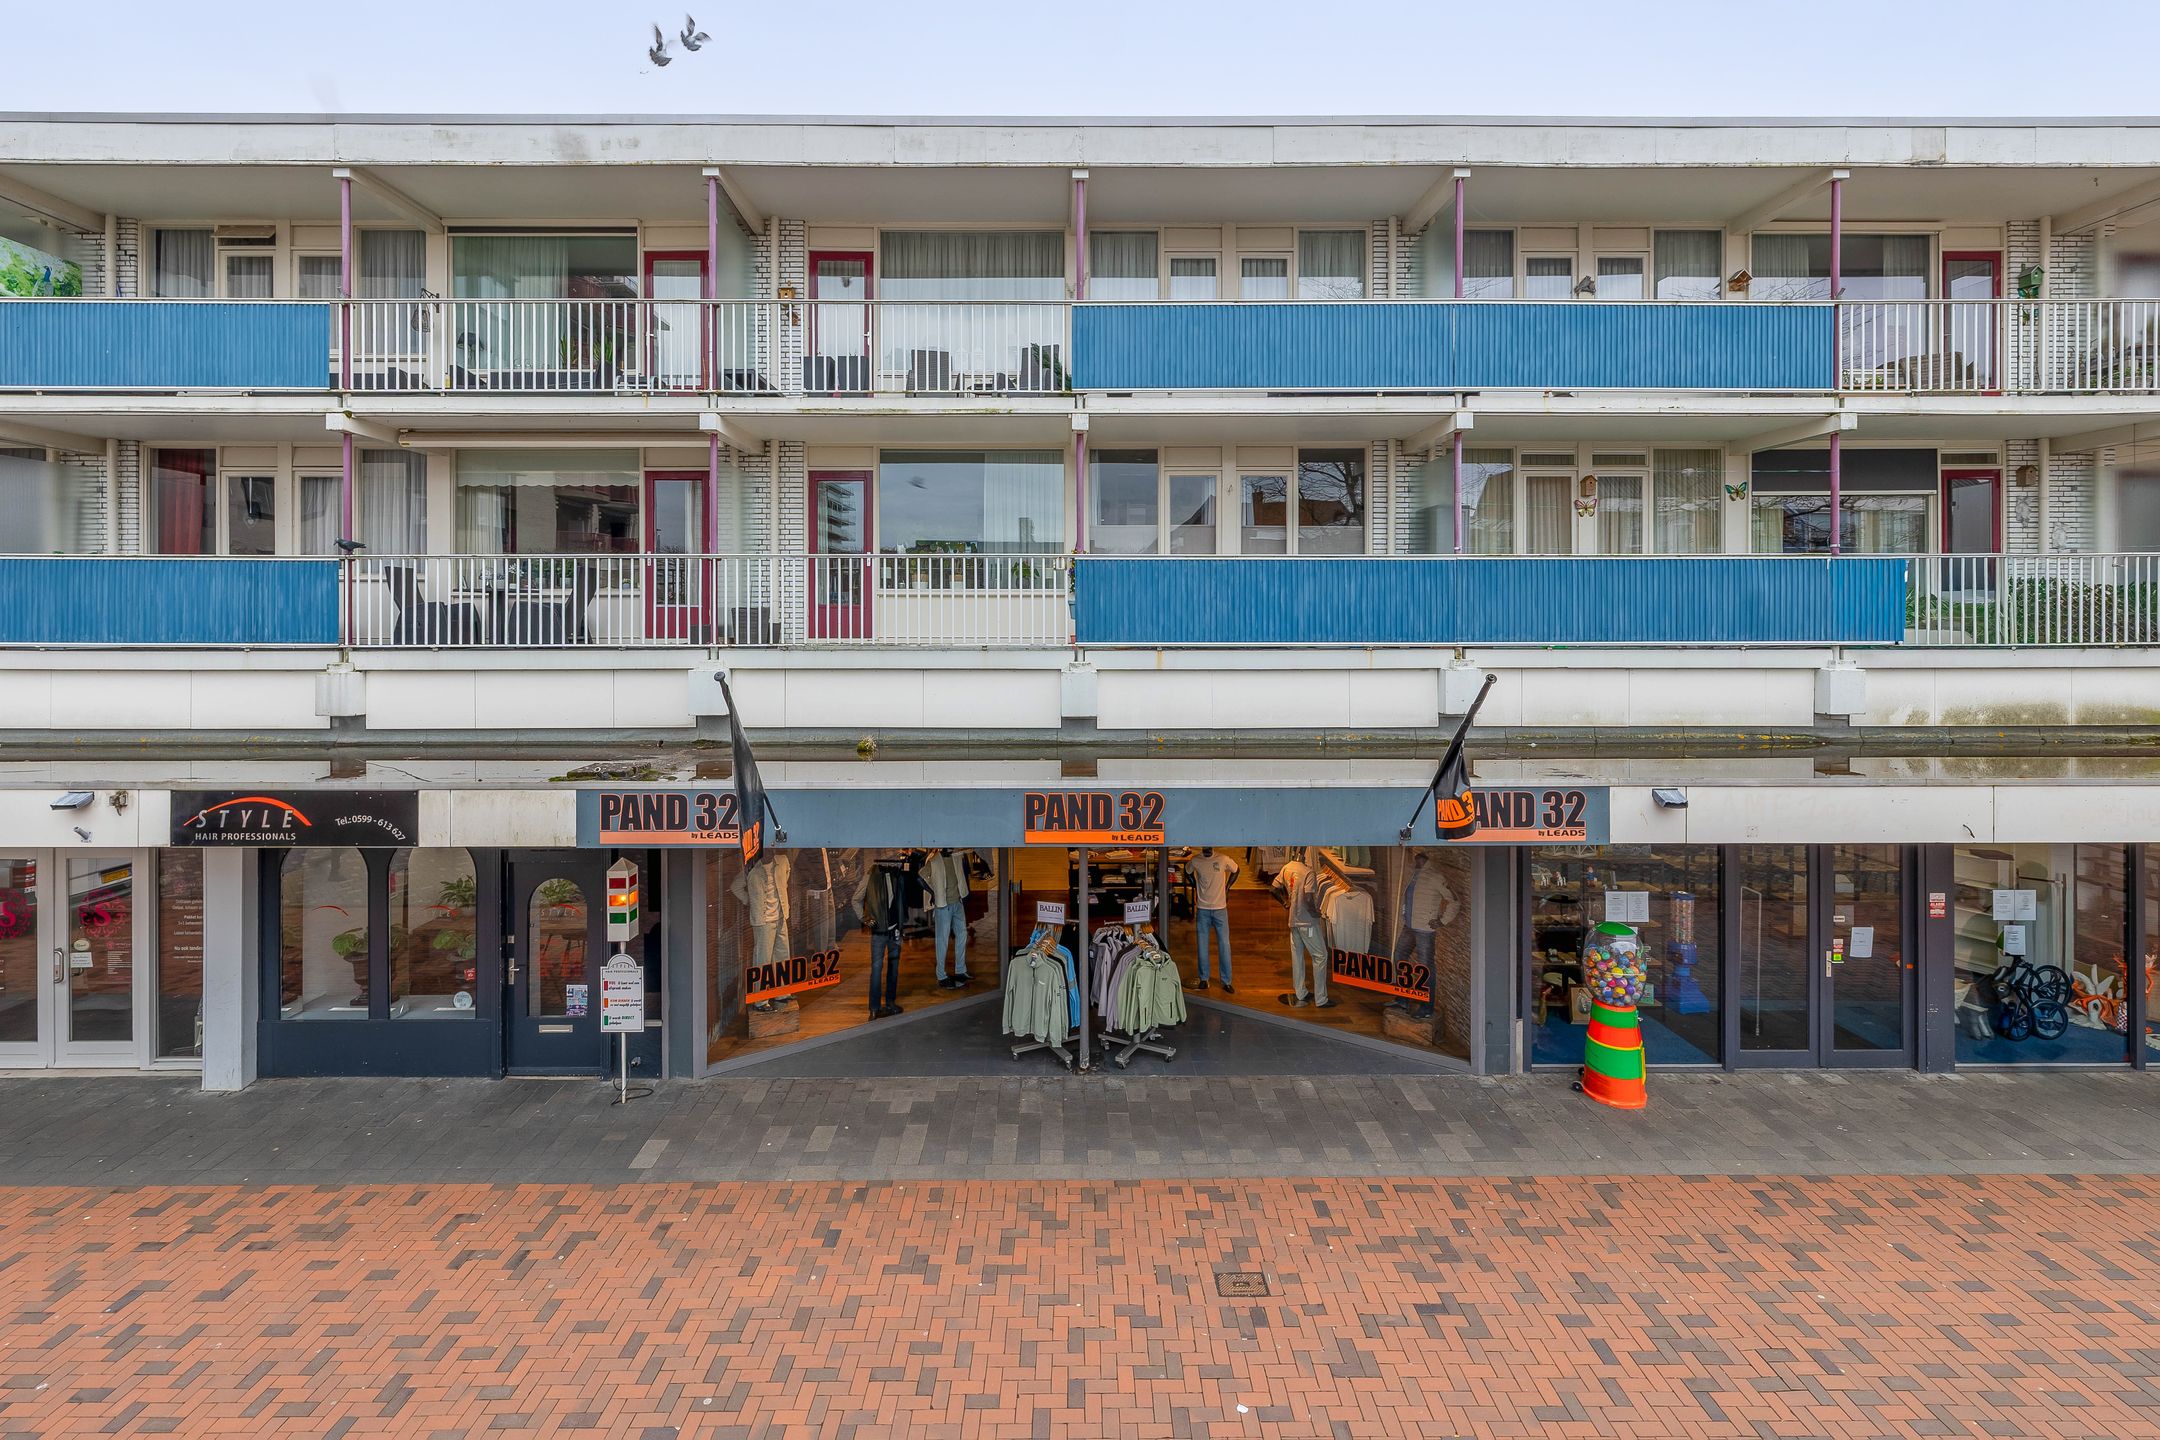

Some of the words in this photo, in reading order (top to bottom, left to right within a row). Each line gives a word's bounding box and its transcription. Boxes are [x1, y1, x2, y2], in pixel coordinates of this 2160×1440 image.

[600, 793, 689, 832] PAND
[694, 793, 739, 832] 32
[1024, 792, 1114, 831] PAND
[1119, 792, 1165, 831] 32
[1472, 790, 1536, 829] AND
[1541, 790, 1587, 829] 32
[195, 809, 294, 829] STYLE
[195, 833, 218, 841] HAIR
[221, 833, 296, 841] PROFESSIONALS
[391, 828, 406, 841] 627
[1546, 829, 1586, 837] LEADS
[1039, 904, 1063, 913] BALLIN
[1126, 904, 1149, 913] BALLIN
[745, 956, 807, 995] PAND
[811, 949, 841, 980] 32
[1332, 948, 1394, 985] PAND
[1396, 960, 1431, 993] 32
[814, 975, 840, 986] LEADS
[1400, 987, 1429, 998] LEADS
